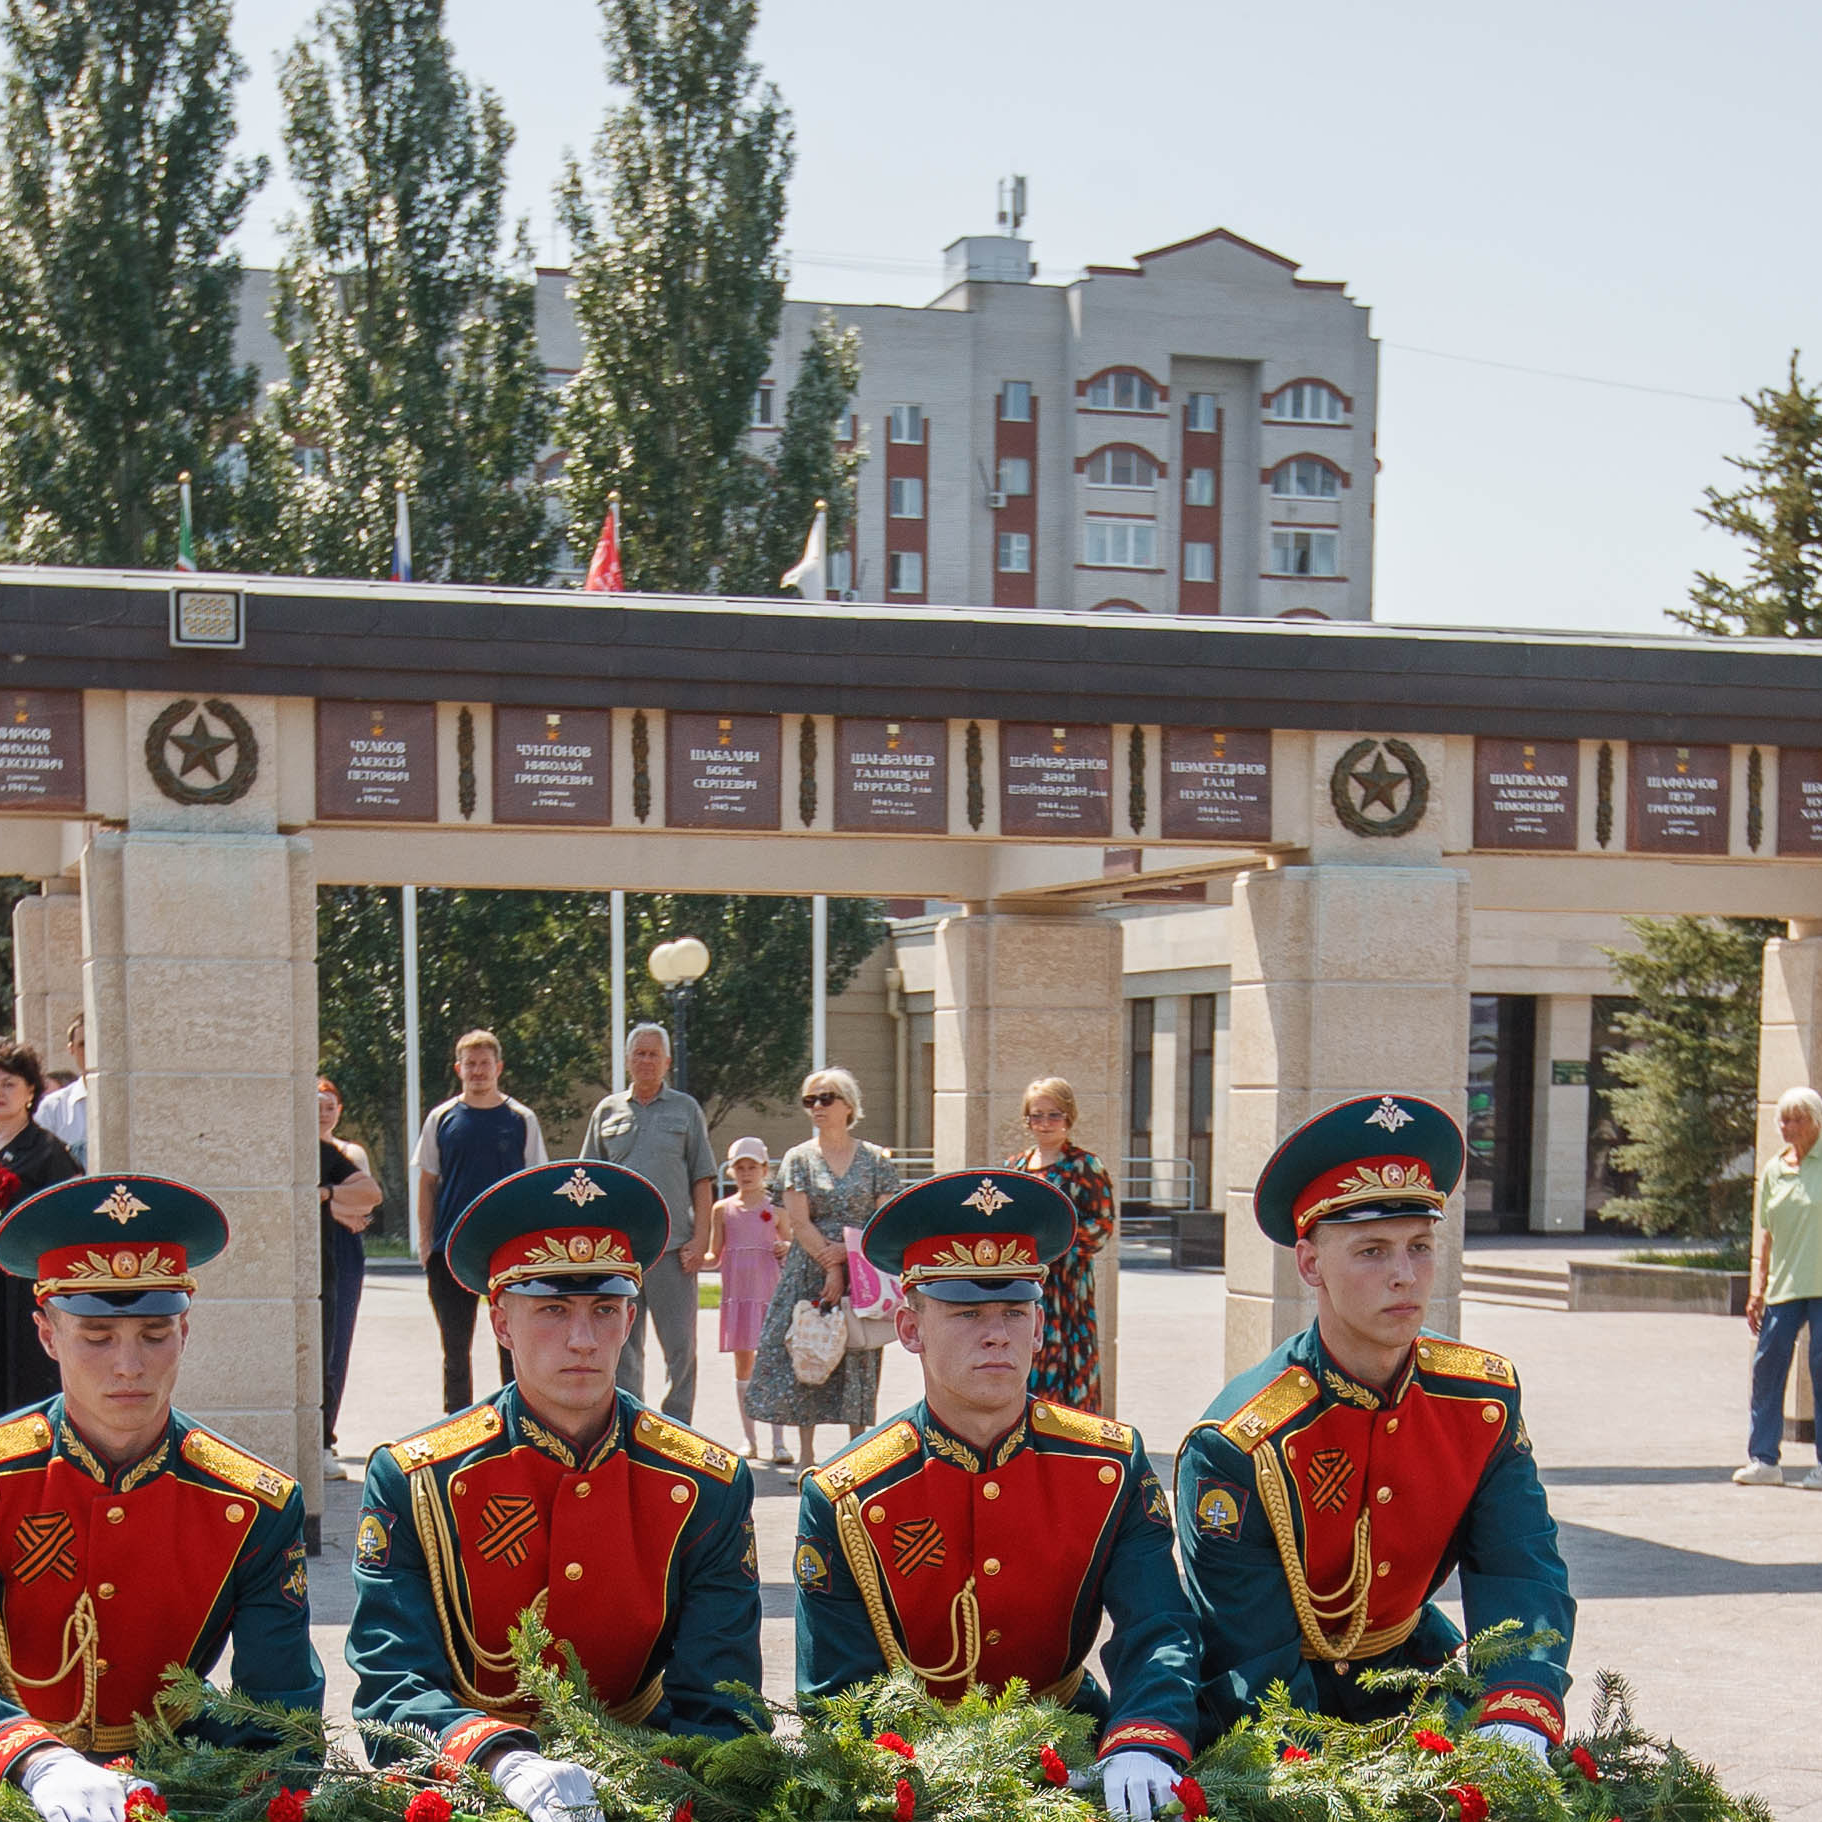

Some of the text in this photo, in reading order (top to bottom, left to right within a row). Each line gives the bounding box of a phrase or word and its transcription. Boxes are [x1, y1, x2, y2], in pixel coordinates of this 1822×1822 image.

[350, 740, 406, 754] ЧУЛКОВ
[516, 744, 592, 758] ЧУНТОНОВ
[350, 754, 406, 768] АЛЕКСЕЙ
[690, 749, 760, 762] ШАБАЛИН
[1010, 753, 1108, 770] ШӘЙМӘРДӘНОВ
[524, 759, 583, 772] НИКОЛАЙ
[706, 765, 744, 776] БОРИС
[1170, 760, 1266, 776] ШӘМСЕТДИНОВ
[347, 770, 410, 782] ПЕТРОВИЧ
[514, 773, 594, 786] ГРИГОРЬЕВИЧ
[1042, 772, 1076, 782] ЗӘКИ
[1202, 776, 1235, 787] ГАЛИ
[1490, 773, 1568, 787] ШАПОВАЛОВ
[693, 778, 758, 790] СЕРГЕЕВИЧ
[854, 782, 910, 792] НУРГАЯЗ
[1008, 782, 1088, 796] ШӘЙМӘРДӘН
[1646, 776, 1718, 790] ШАФРАНОВ
[1180, 789, 1237, 800] НУРУЛЛА
[1498, 789, 1559, 800] АЛЕКСАНДР
[1493, 801, 1564, 813] ТИМОФЕЕВИЧ
